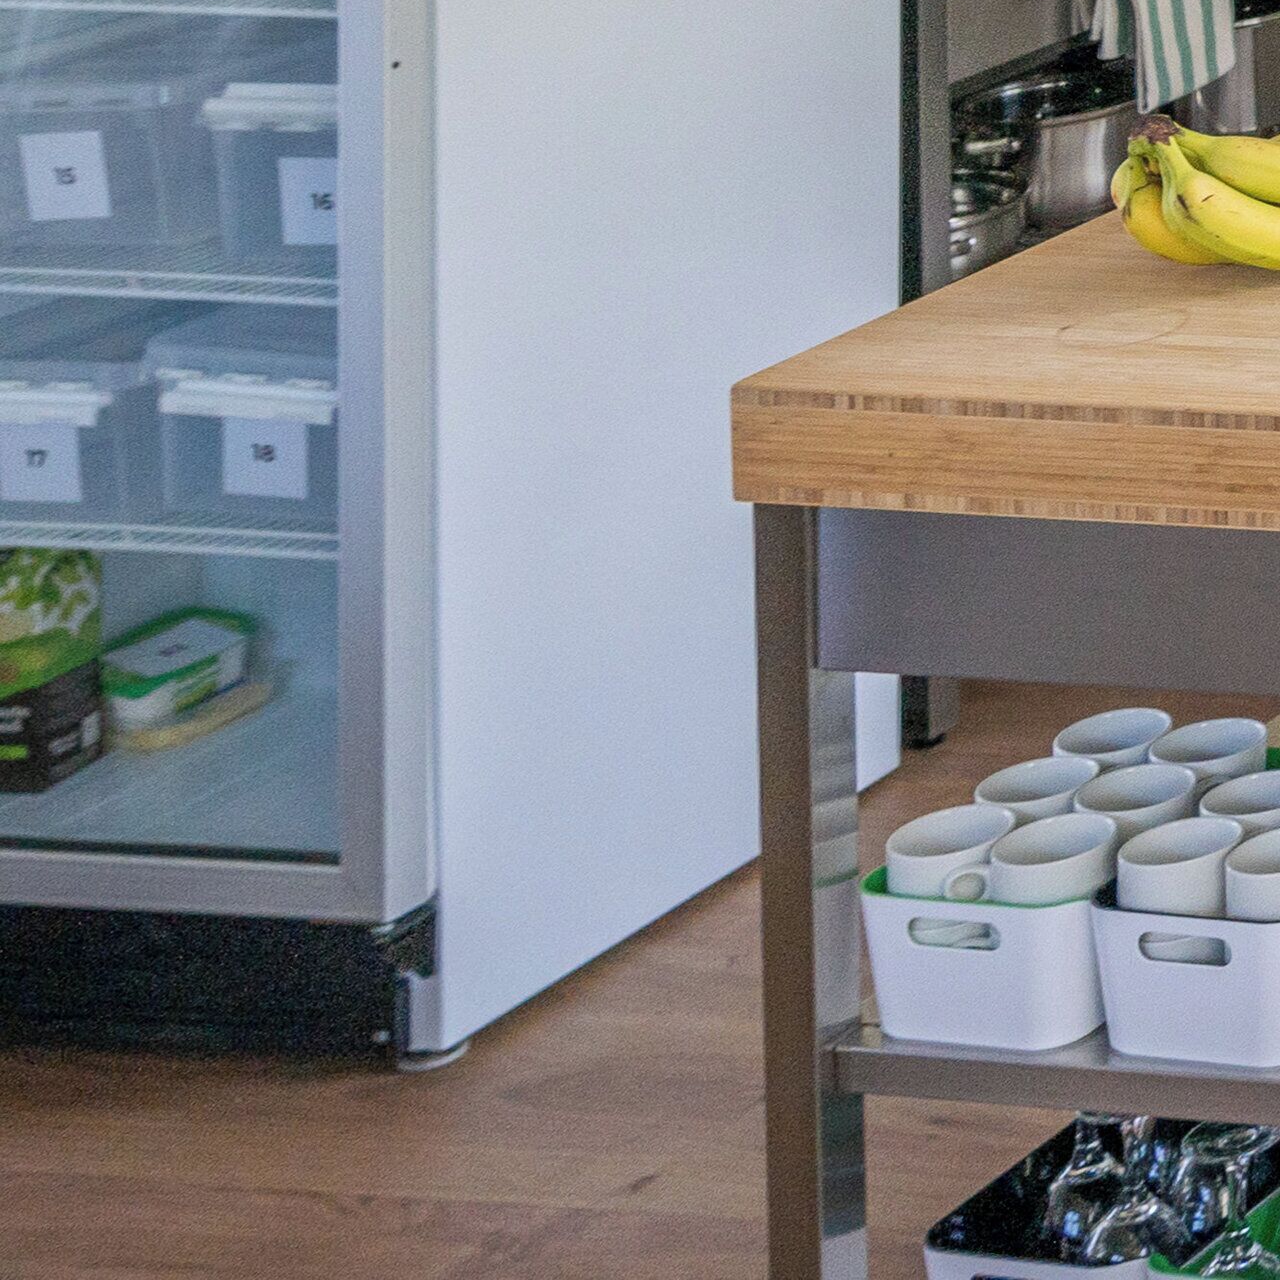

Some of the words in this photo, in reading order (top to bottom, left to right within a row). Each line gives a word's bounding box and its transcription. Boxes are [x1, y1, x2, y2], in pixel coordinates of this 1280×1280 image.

[54, 166, 77, 186] 15
[310, 191, 335, 211] 16
[25, 448, 48, 468] 17
[250, 442, 275, 462] 18
